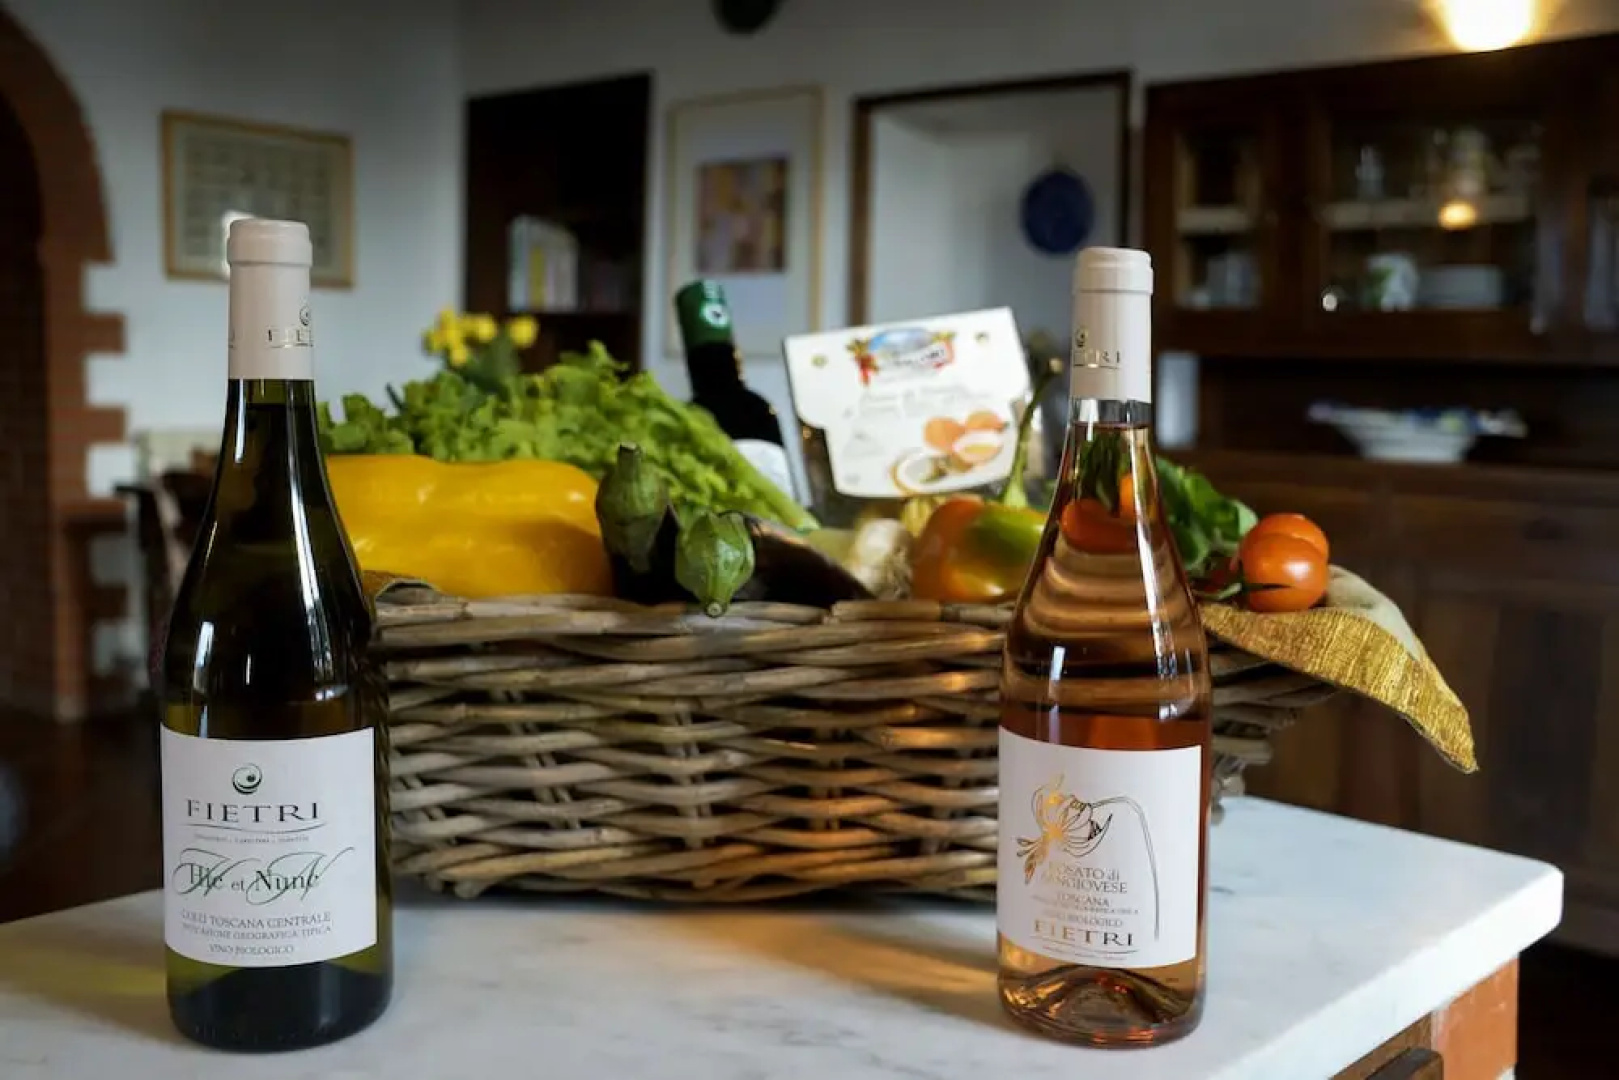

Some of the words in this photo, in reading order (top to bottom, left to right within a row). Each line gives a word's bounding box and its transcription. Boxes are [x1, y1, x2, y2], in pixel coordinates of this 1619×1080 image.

[187, 799, 319, 823] FIETRI
[230, 877, 246, 893] et
[210, 914, 265, 929] TOSCANA
[266, 911, 332, 928] CENTRALE
[1034, 919, 1132, 946] FIETRI
